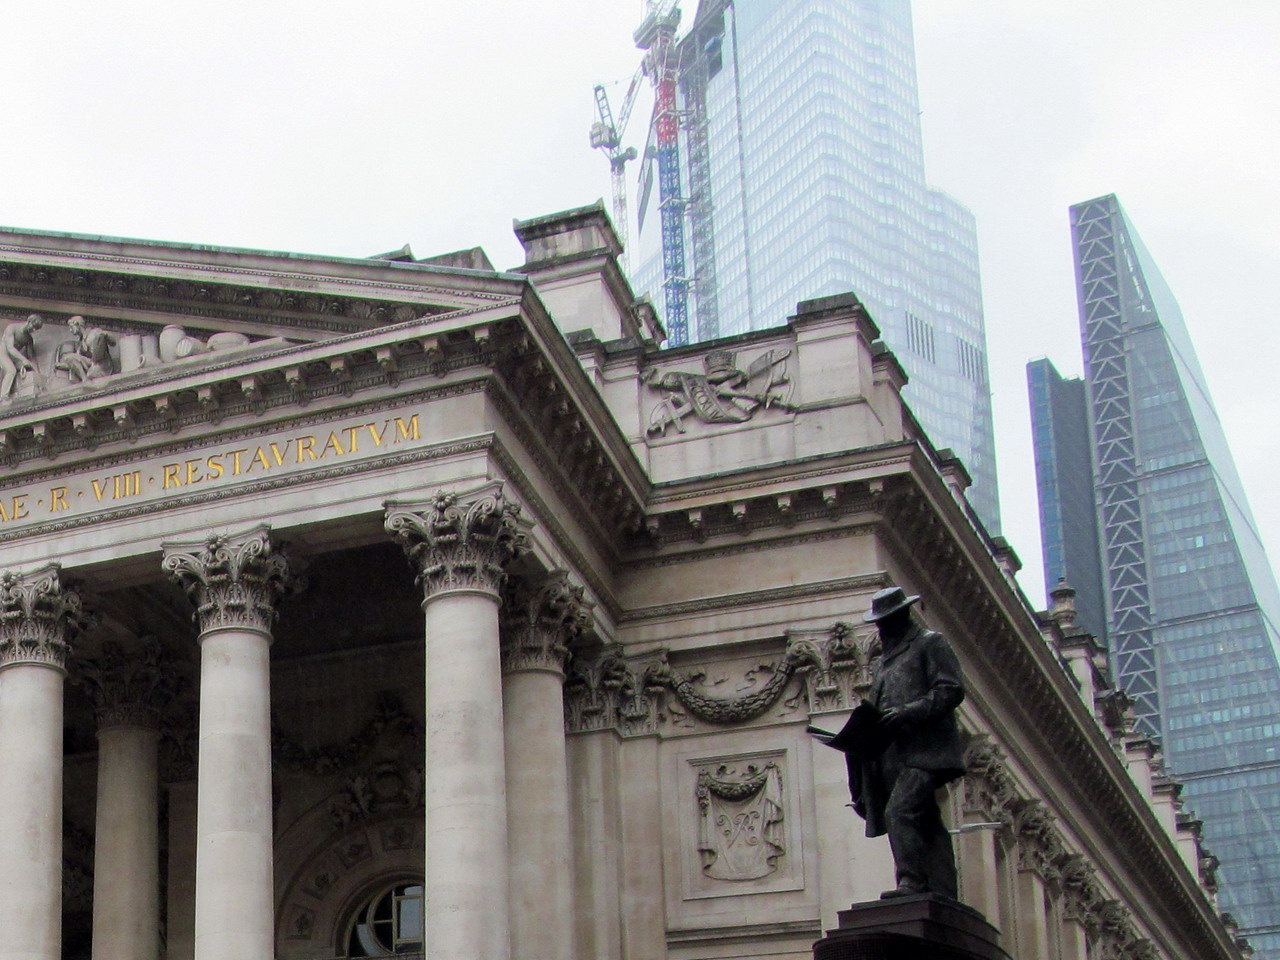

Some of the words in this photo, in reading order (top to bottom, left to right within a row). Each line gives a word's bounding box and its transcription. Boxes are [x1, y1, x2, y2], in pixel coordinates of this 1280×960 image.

[50, 486, 70, 513] R
[90, 471, 141, 502] VIII
[162, 414, 421, 490] RESTAVRATVM
